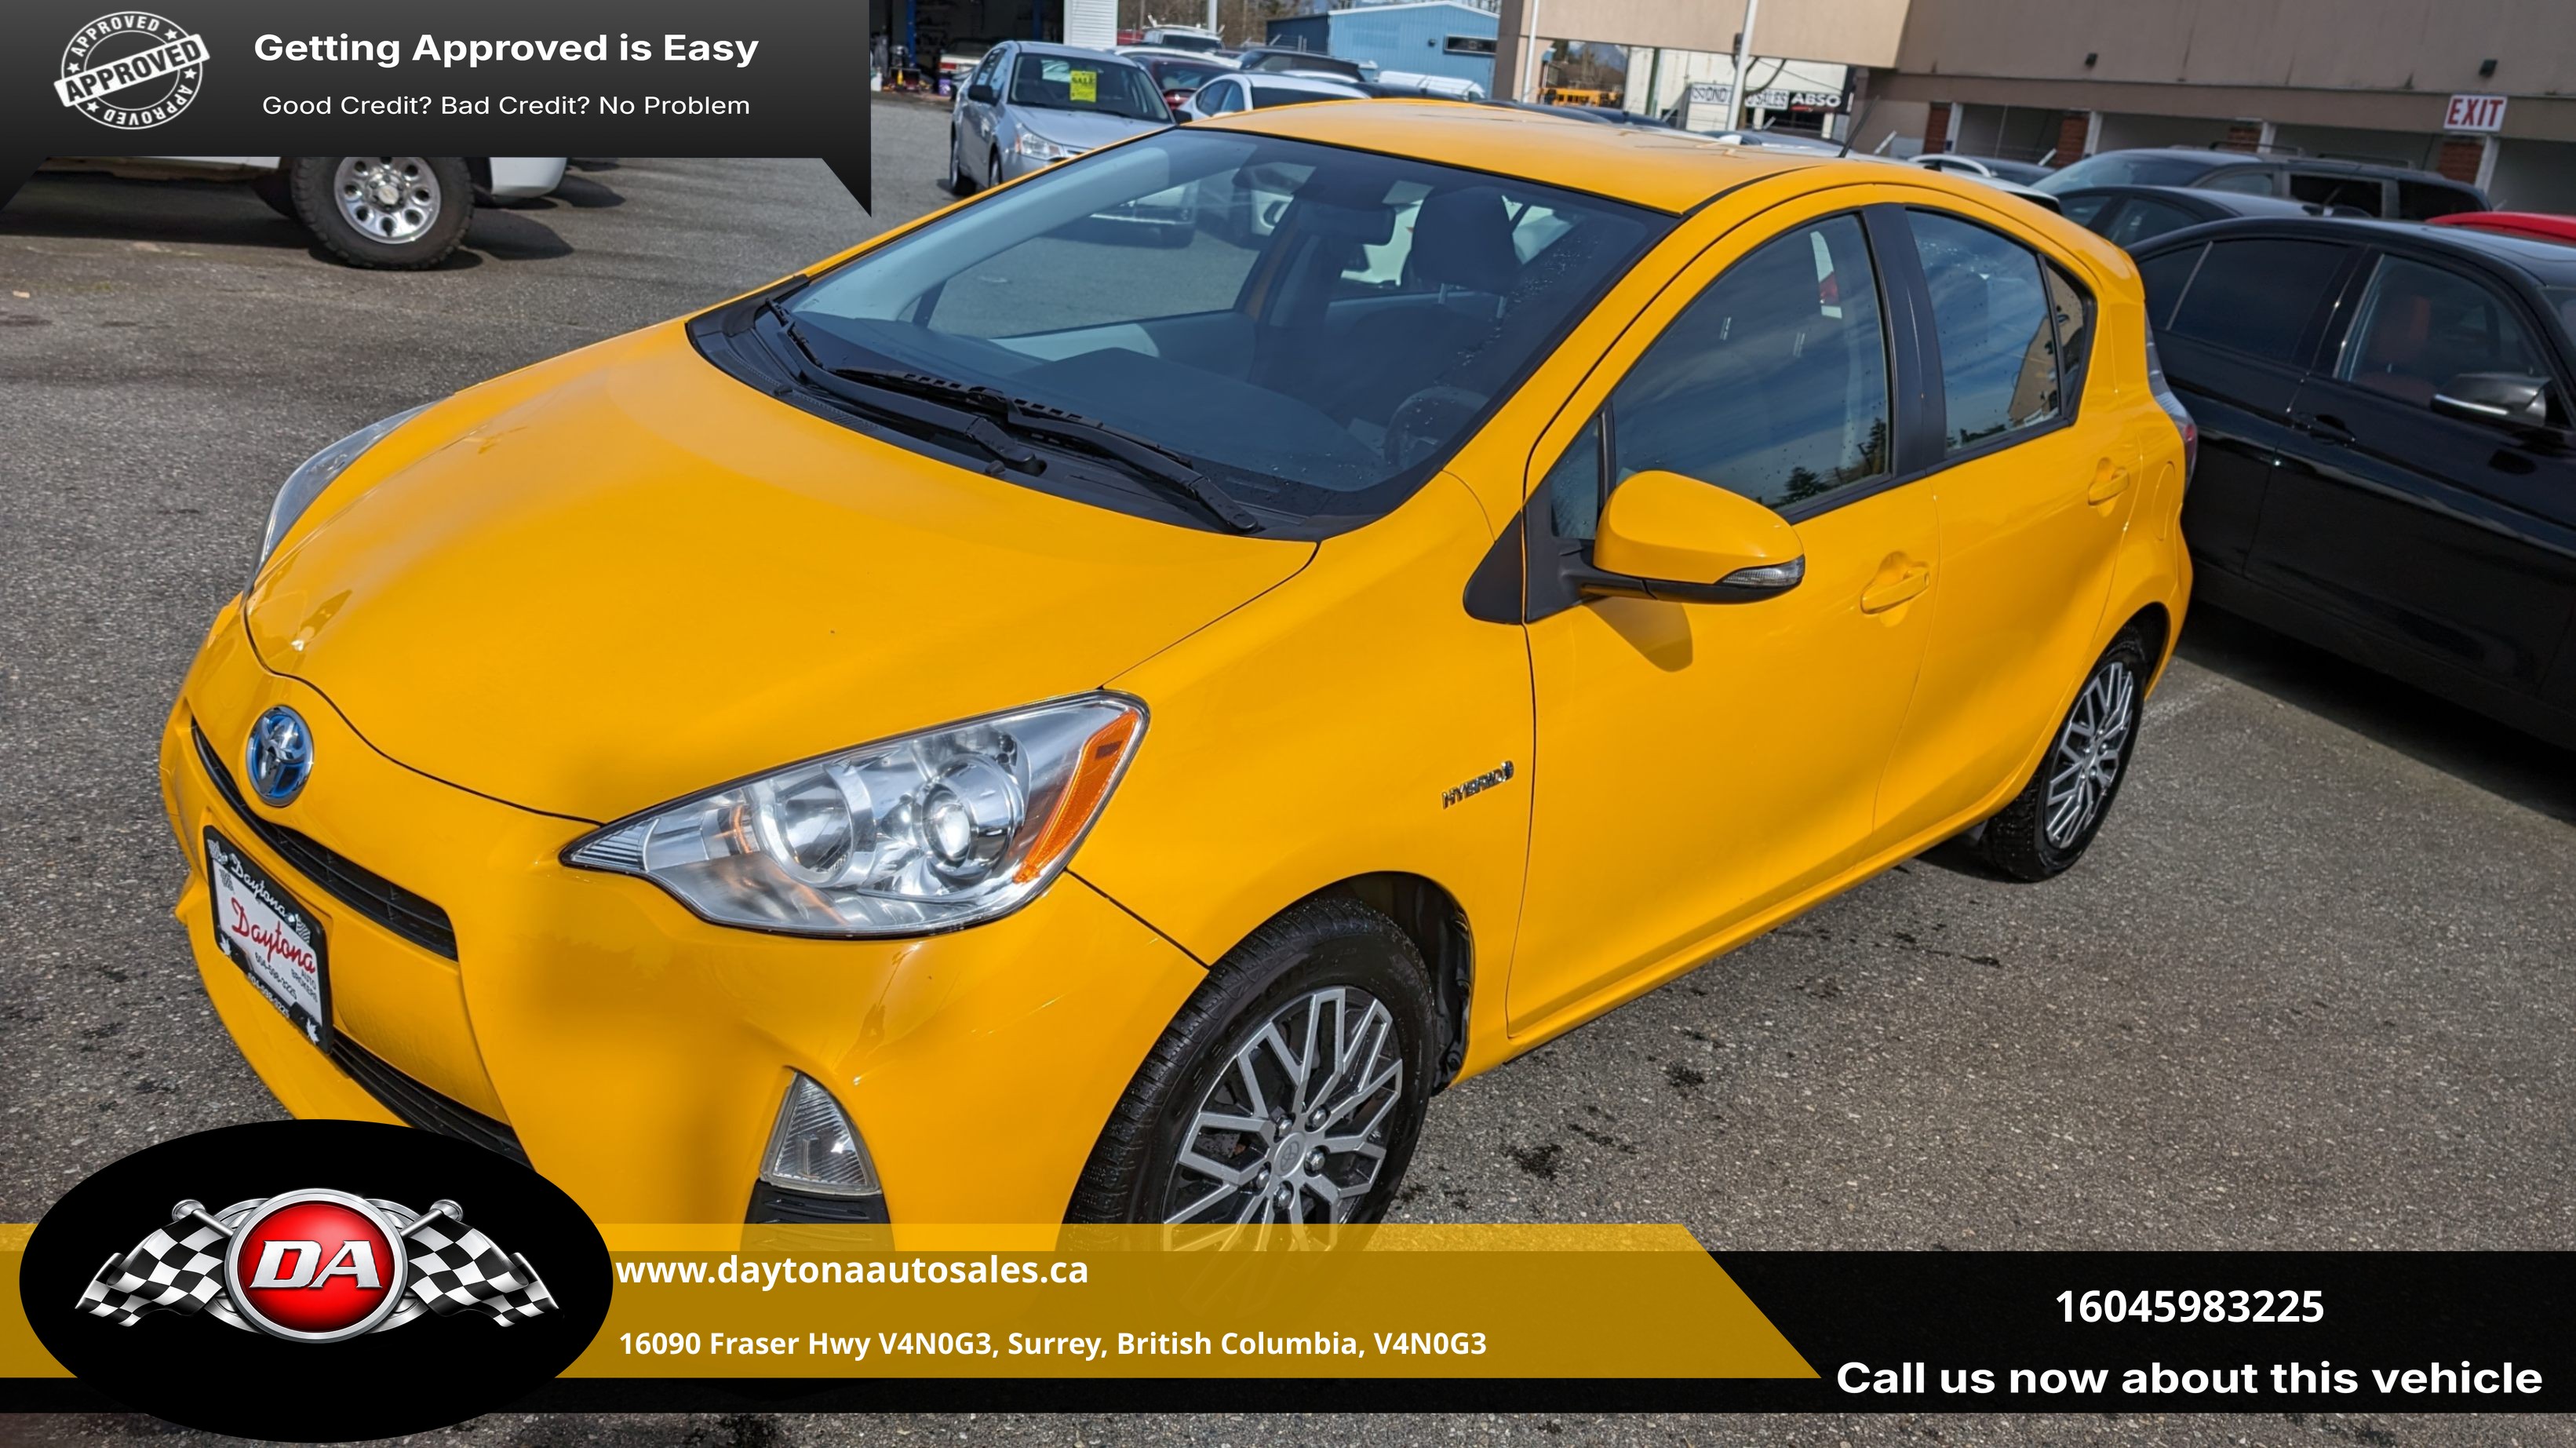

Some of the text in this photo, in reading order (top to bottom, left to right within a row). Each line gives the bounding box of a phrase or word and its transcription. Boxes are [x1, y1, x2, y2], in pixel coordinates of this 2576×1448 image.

[2447, 98, 2504, 127] EXIT
[228, 852, 287, 917] Daytona
[231, 896, 316, 974] Daytona
